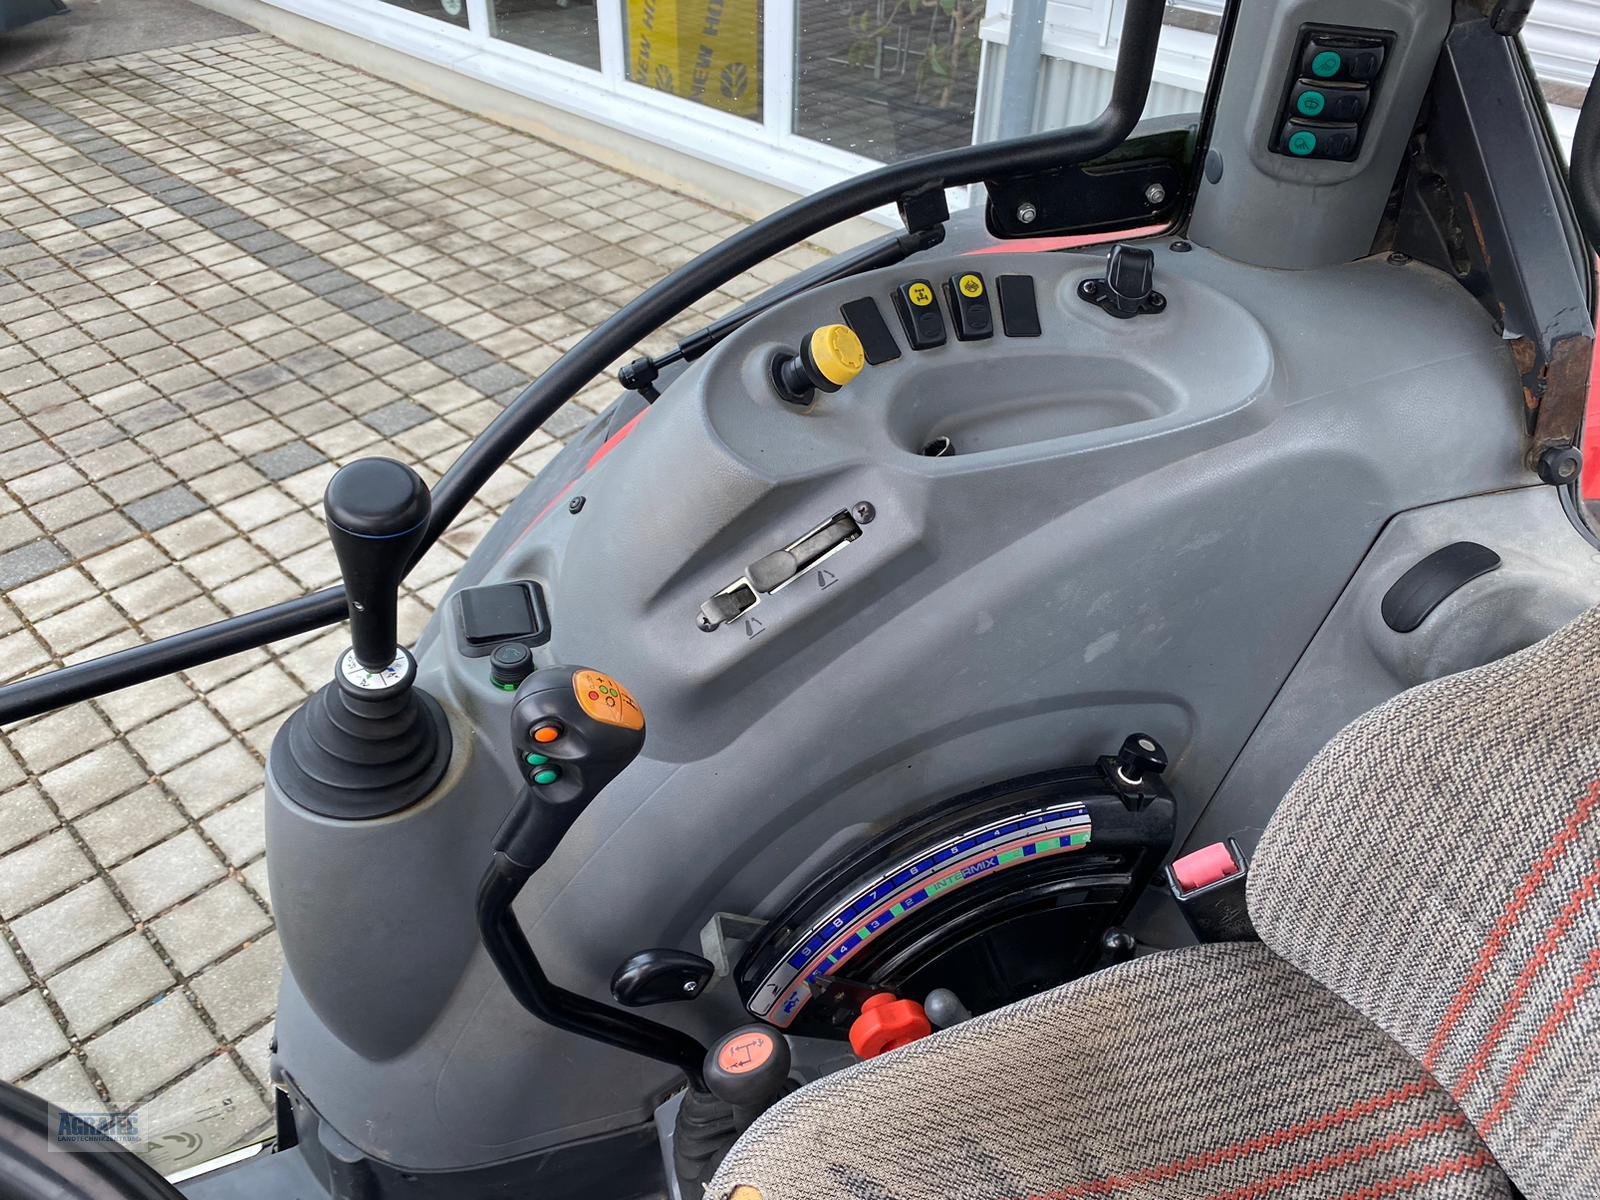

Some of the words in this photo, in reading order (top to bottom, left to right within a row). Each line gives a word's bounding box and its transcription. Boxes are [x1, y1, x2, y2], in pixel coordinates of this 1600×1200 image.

[637, 34, 651, 84] NEW
[690, 44, 713, 98] NEW
[832, 917, 843, 928] 8
[869, 891, 877, 900] 7
[909, 866, 919, 875] 6
[840, 945, 848, 953] 4
[871, 920, 880, 929] 3
[906, 898, 914, 906] 2
[934, 857, 996, 891] INTERMIX
